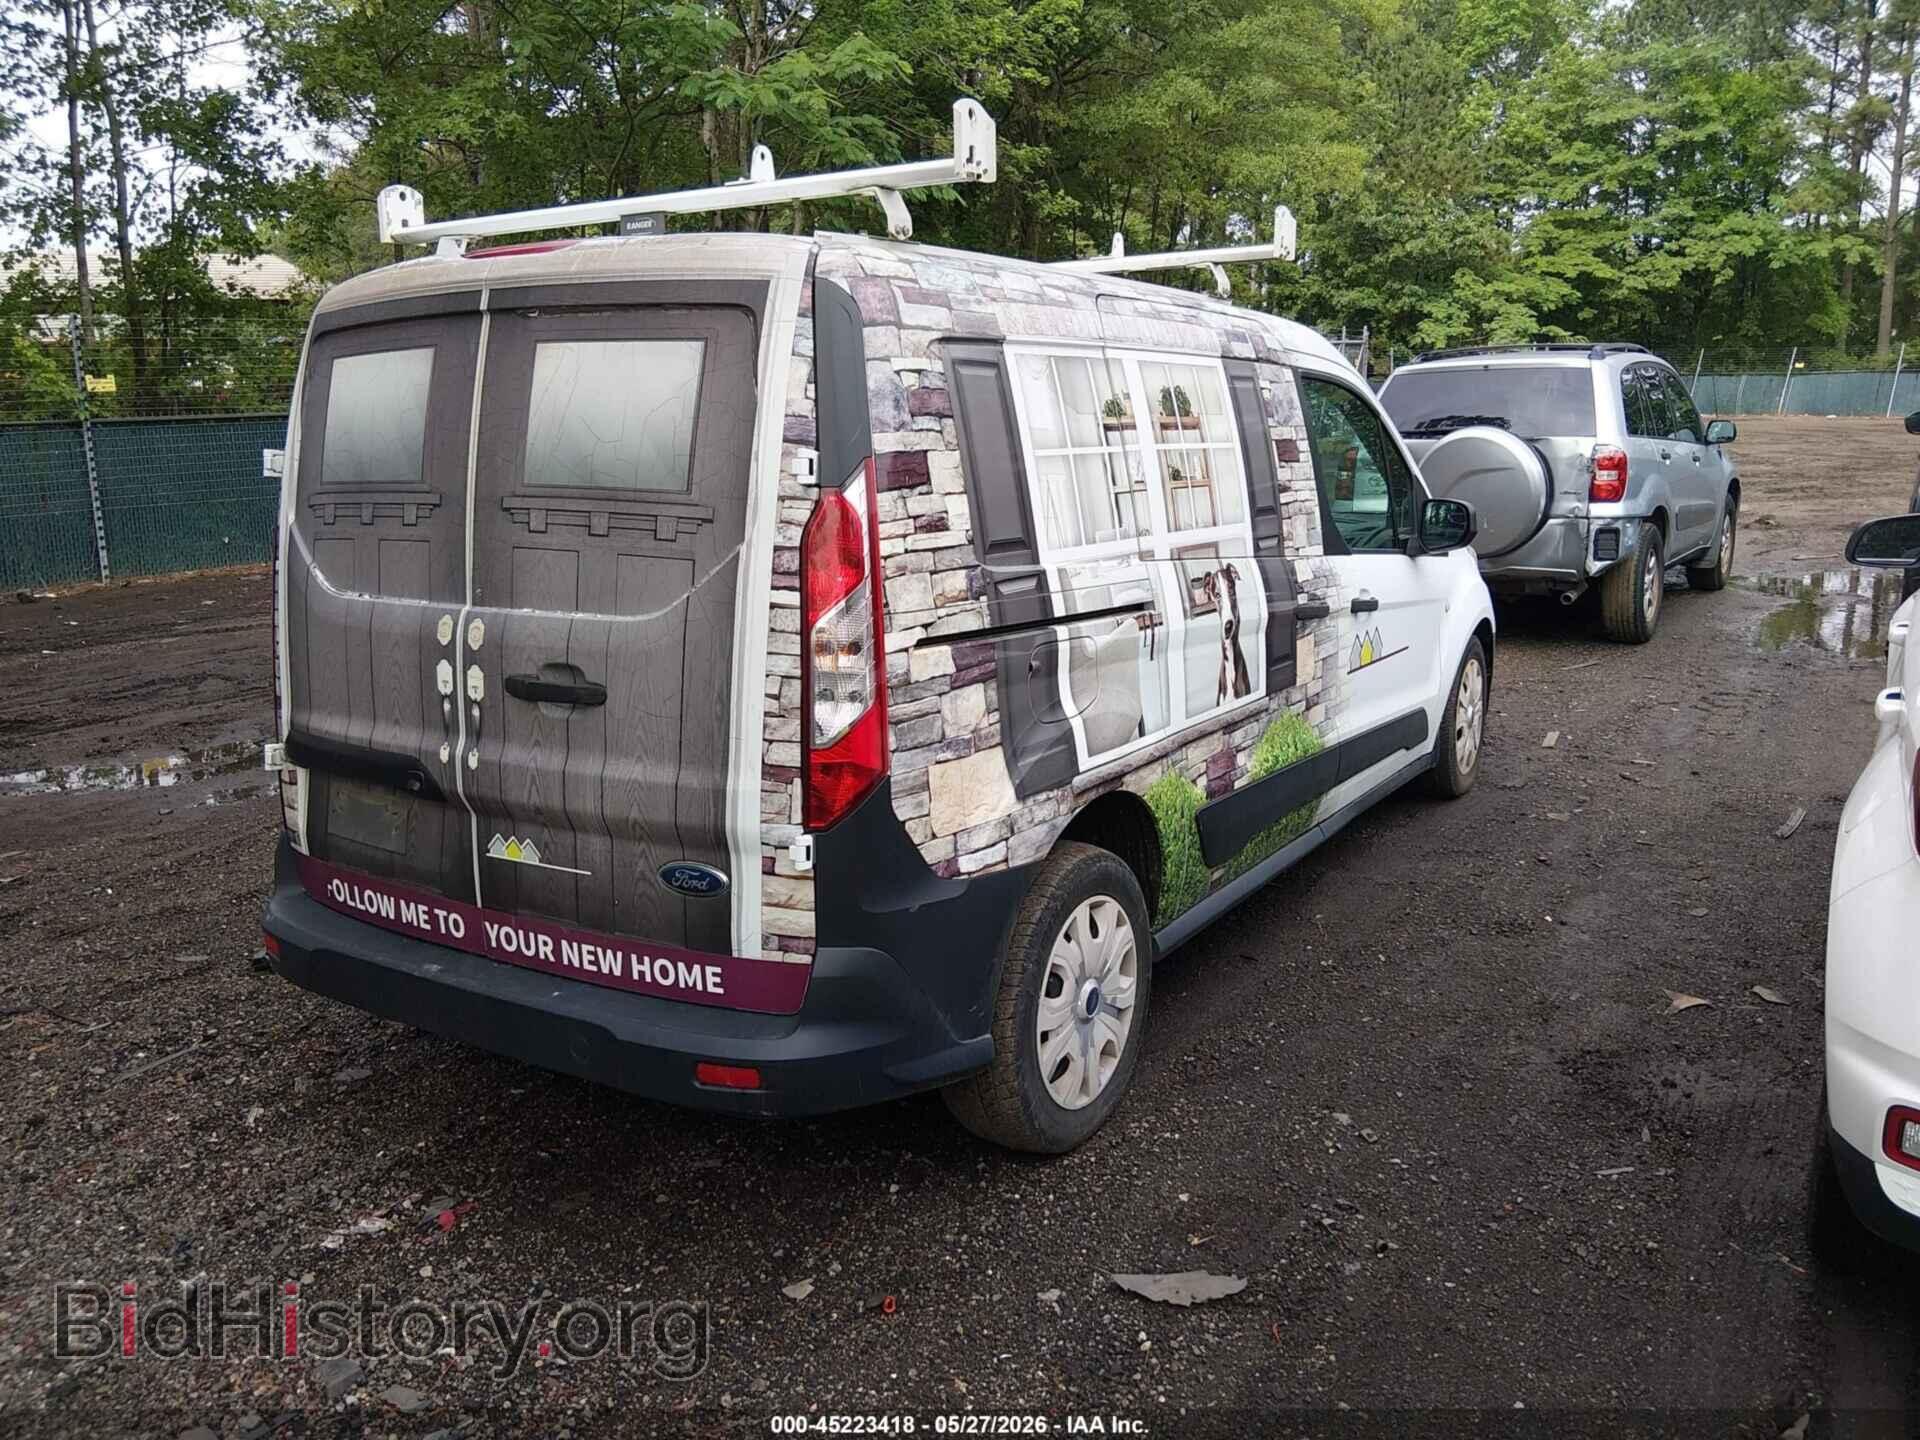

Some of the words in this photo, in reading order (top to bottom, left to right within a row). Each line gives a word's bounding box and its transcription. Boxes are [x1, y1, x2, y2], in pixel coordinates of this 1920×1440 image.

[671, 868, 710, 890] Ford
[399, 899, 432, 931] ME
[433, 908, 466, 939] TO
[484, 921, 556, 962] YOUR
[560, 939, 623, 977] NEW
[630, 953, 725, 994] HOME
